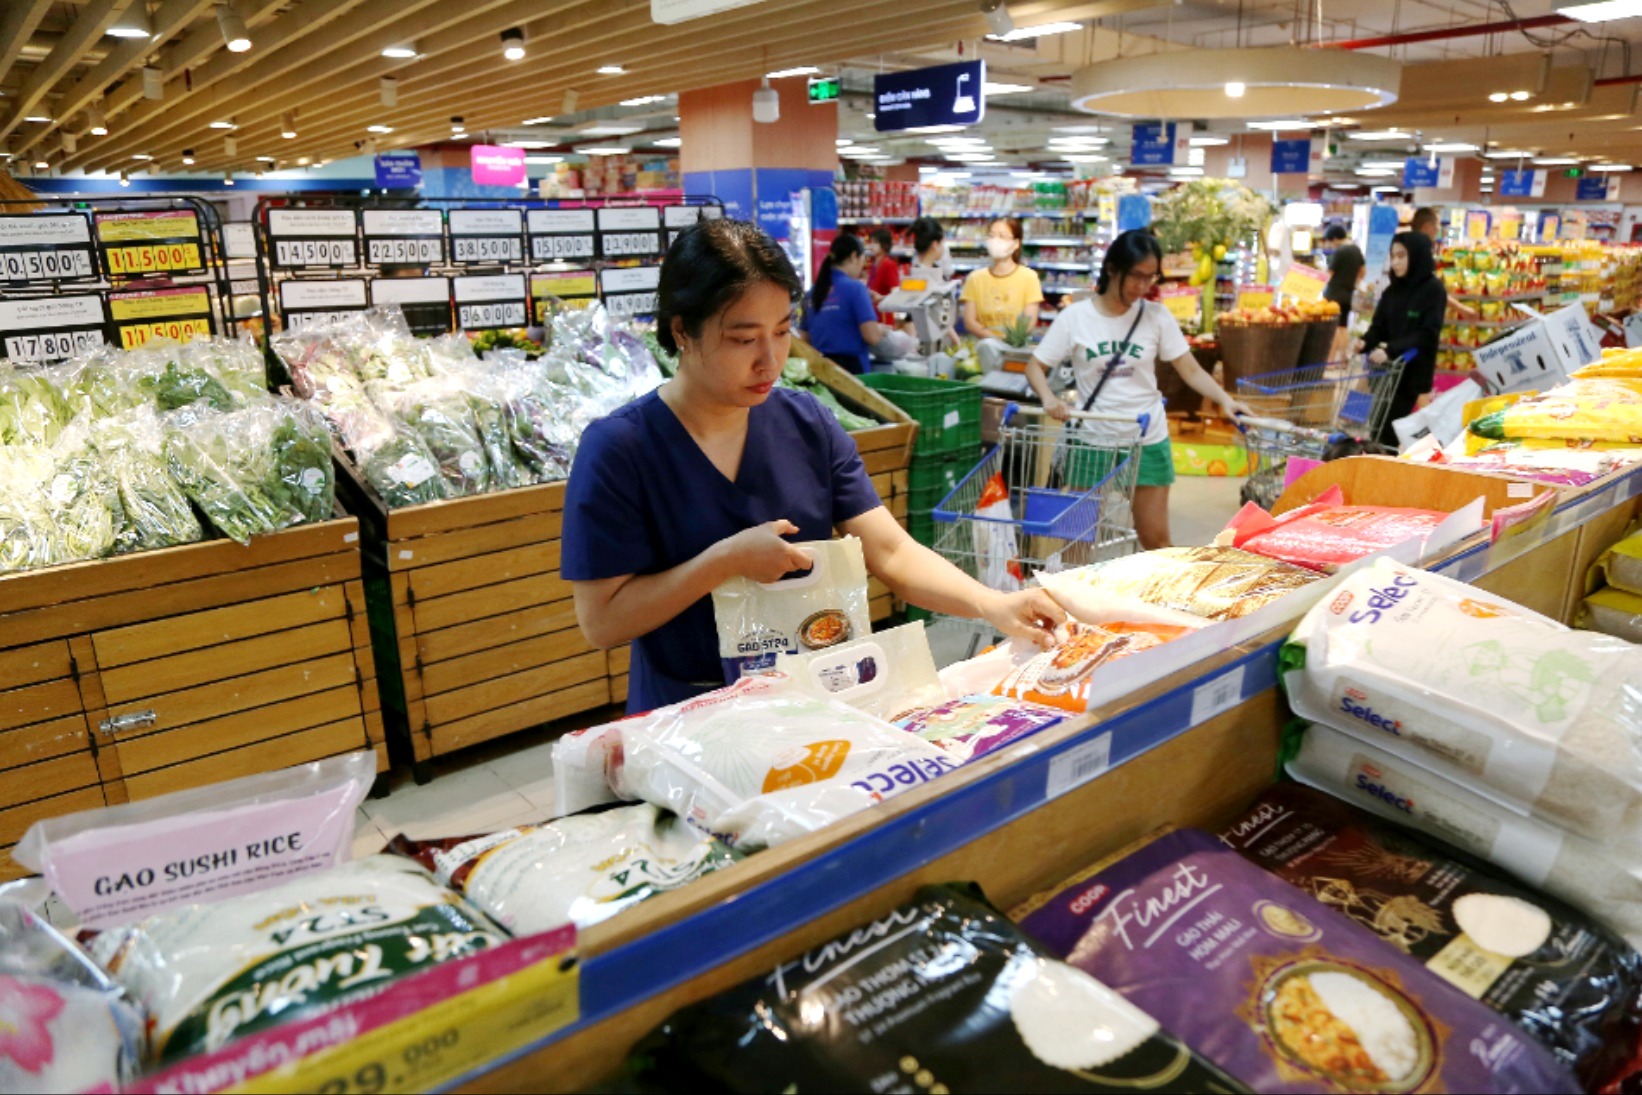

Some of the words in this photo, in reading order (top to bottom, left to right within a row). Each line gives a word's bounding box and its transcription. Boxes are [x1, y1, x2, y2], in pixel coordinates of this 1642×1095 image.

[112, 246, 184, 267] 11.500
[1348, 571, 1418, 624] Selec
[164, 848, 238, 883] SUSHI
[247, 831, 305, 861] RICE
[1093, 862, 1208, 951] Finest
